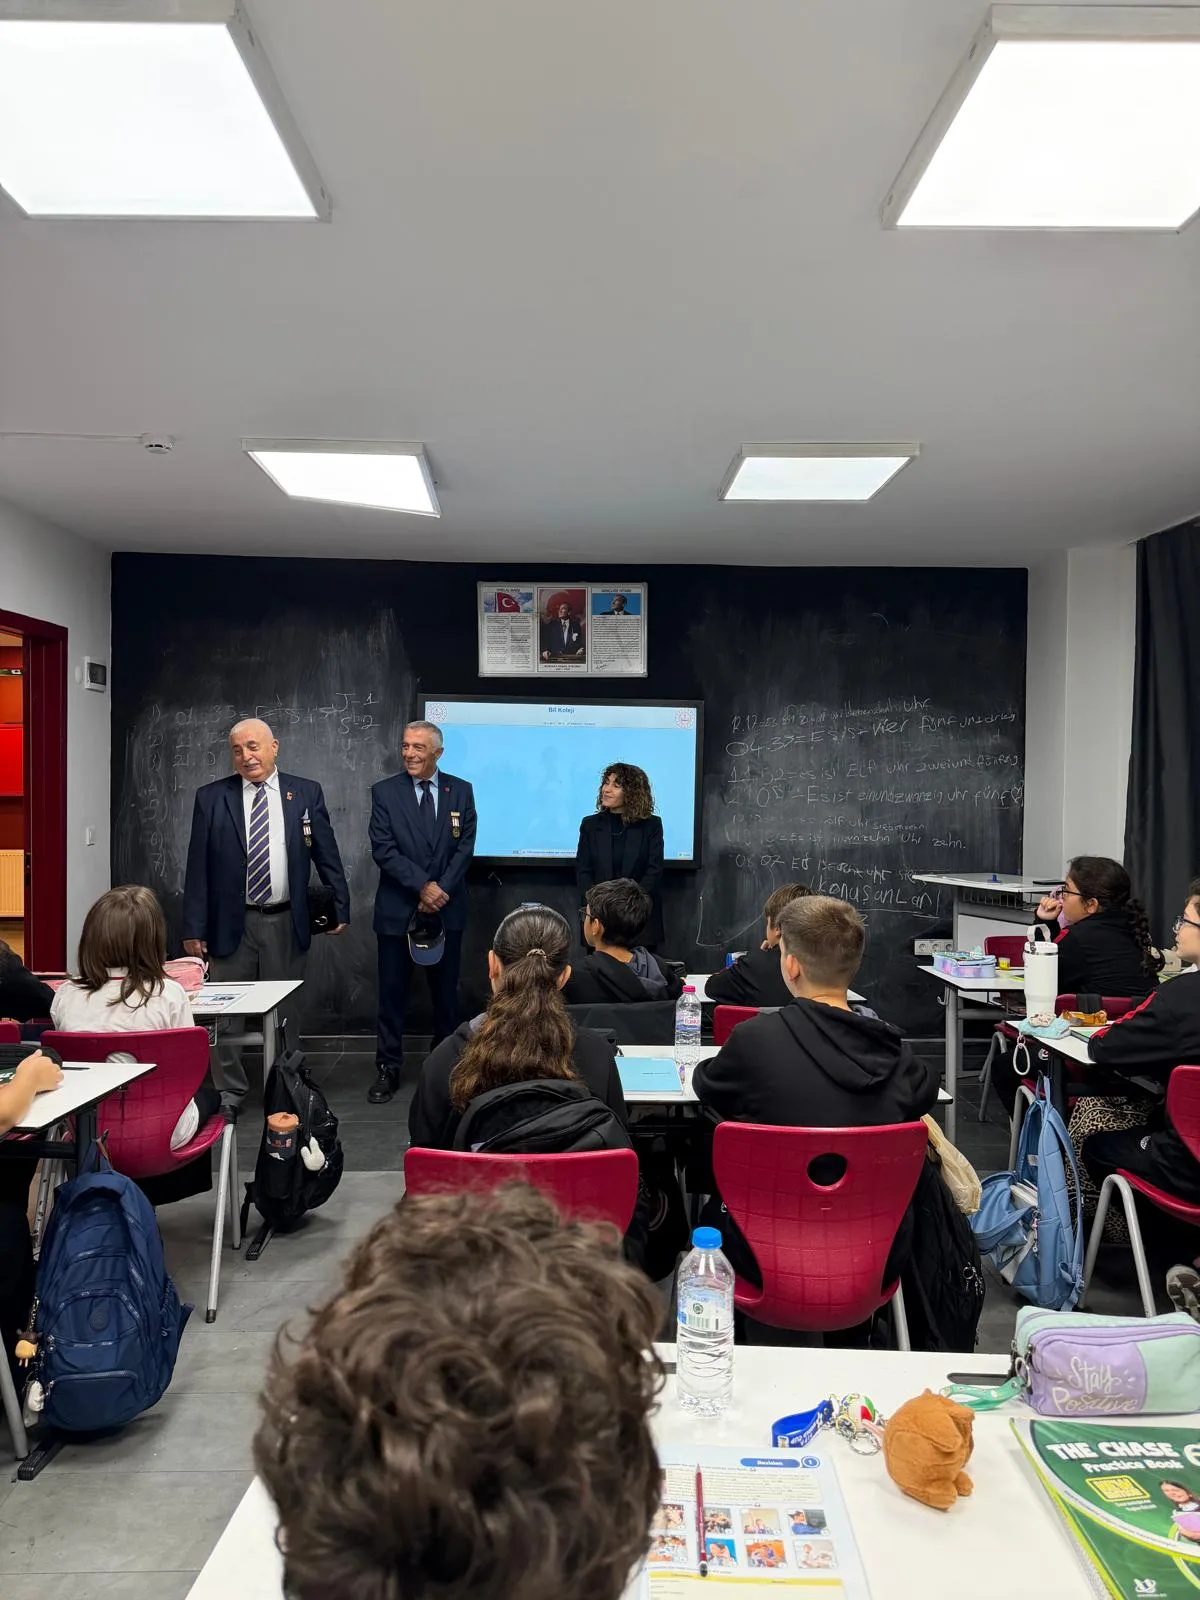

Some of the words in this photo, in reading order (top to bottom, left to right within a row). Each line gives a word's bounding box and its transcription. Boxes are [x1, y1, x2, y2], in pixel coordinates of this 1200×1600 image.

[1066, 1355, 1122, 1394] Stay
[1052, 1387, 1138, 1414] Positive
[1045, 1442, 1099, 1460] THE
[1098, 1441, 1180, 1459] CHASE
[1081, 1461, 1145, 1474] Practice
[1145, 1459, 1184, 1470] Book
